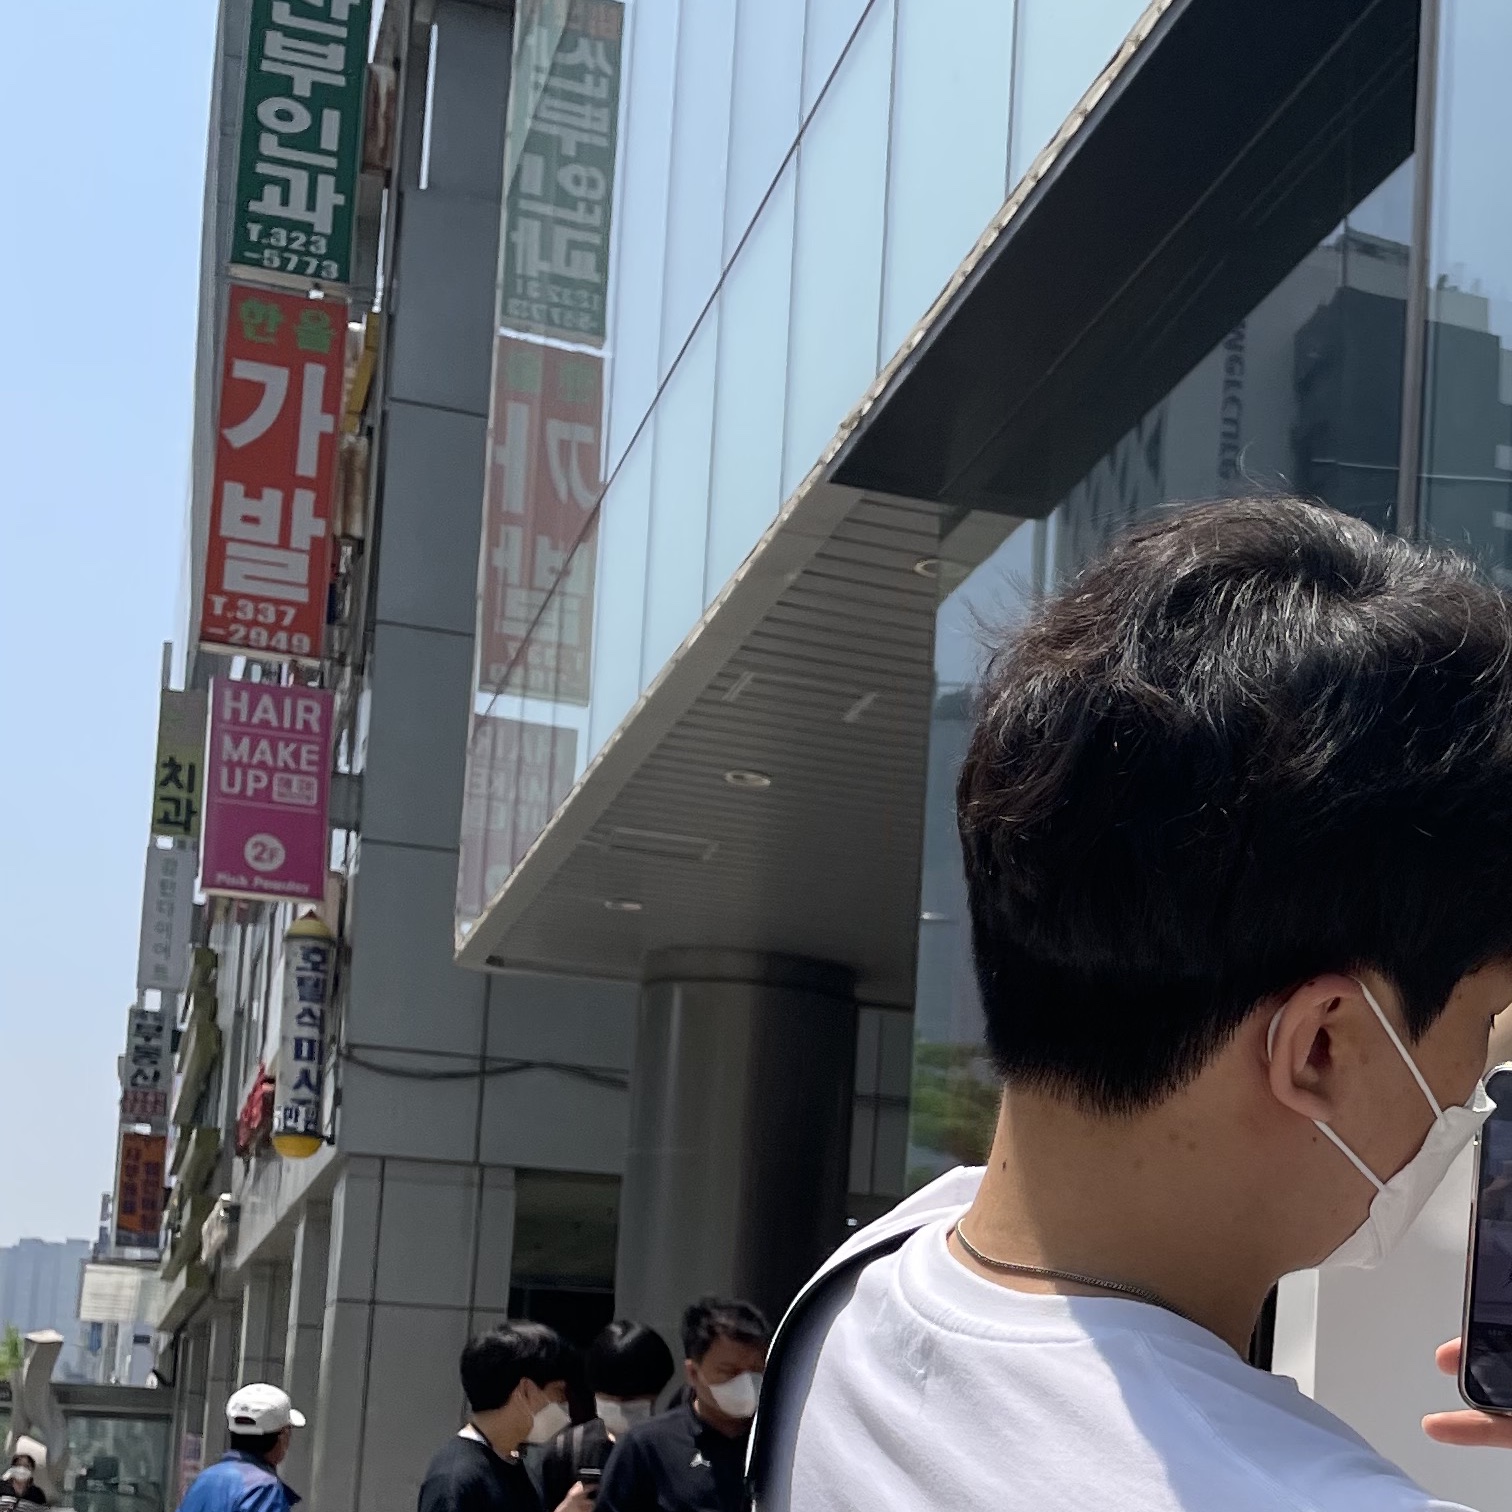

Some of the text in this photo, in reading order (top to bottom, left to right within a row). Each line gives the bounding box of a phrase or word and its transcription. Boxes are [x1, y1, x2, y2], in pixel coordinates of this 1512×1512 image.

[246, 222, 328, 255] T.323
[220, 359, 334, 604] 가발
[208, 594, 298, 627] T.337
[222, 687, 322, 734] HAIR
[221, 734, 320, 773] MAKE
[156, 756, 198, 832] 치과
[219, 766, 269, 798] UP
